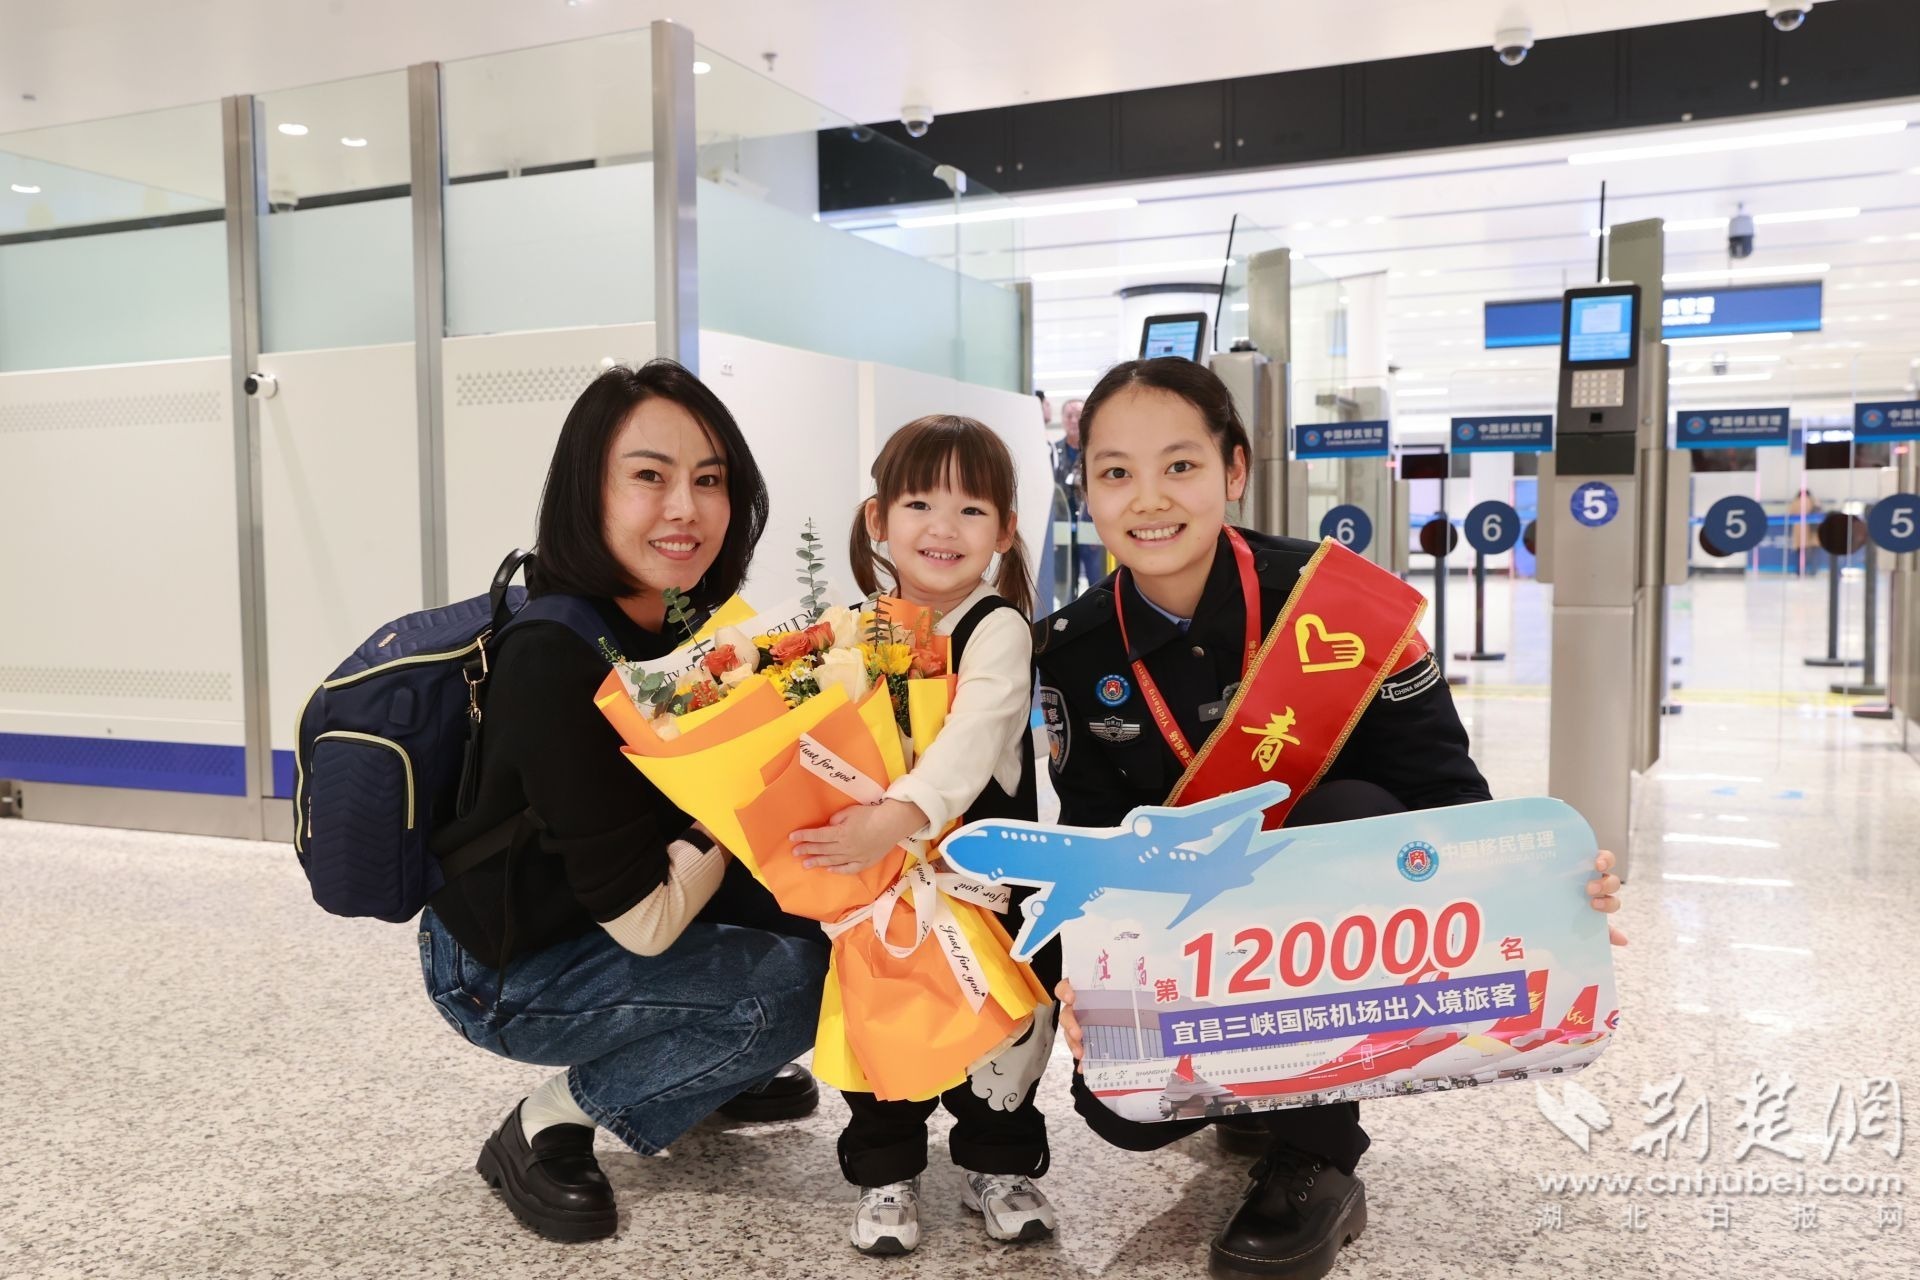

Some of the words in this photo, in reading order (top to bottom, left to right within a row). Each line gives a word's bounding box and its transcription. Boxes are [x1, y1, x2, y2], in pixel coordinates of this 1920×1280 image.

[1323, 428, 1383, 440] 中国移民管理
[1478, 422, 1543, 434] 中国移民管理
[1709, 415, 1782, 428] 中国移民管理
[1583, 489, 1608, 520] 5
[1337, 518, 1355, 545] 6
[1482, 514, 1502, 541] 6
[1725, 510, 1747, 539] 5
[1890, 508, 1915, 538] 5
[1148, 688, 1170, 728] Yichang
[811, 758, 834, 770] for
[830, 770, 852, 783] you
[1441, 830, 1556, 860] 中国移民管理
[939, 925, 962, 953] Just
[951, 949, 970, 971] for
[962, 973, 981, 996] you
[1154, 978, 1179, 1003] 第
[1184, 902, 1481, 998] 120000
[1500, 937, 1525, 961] 名
[1171, 983, 1517, 1046] 宜昌三峡国际机场出入境旅客
